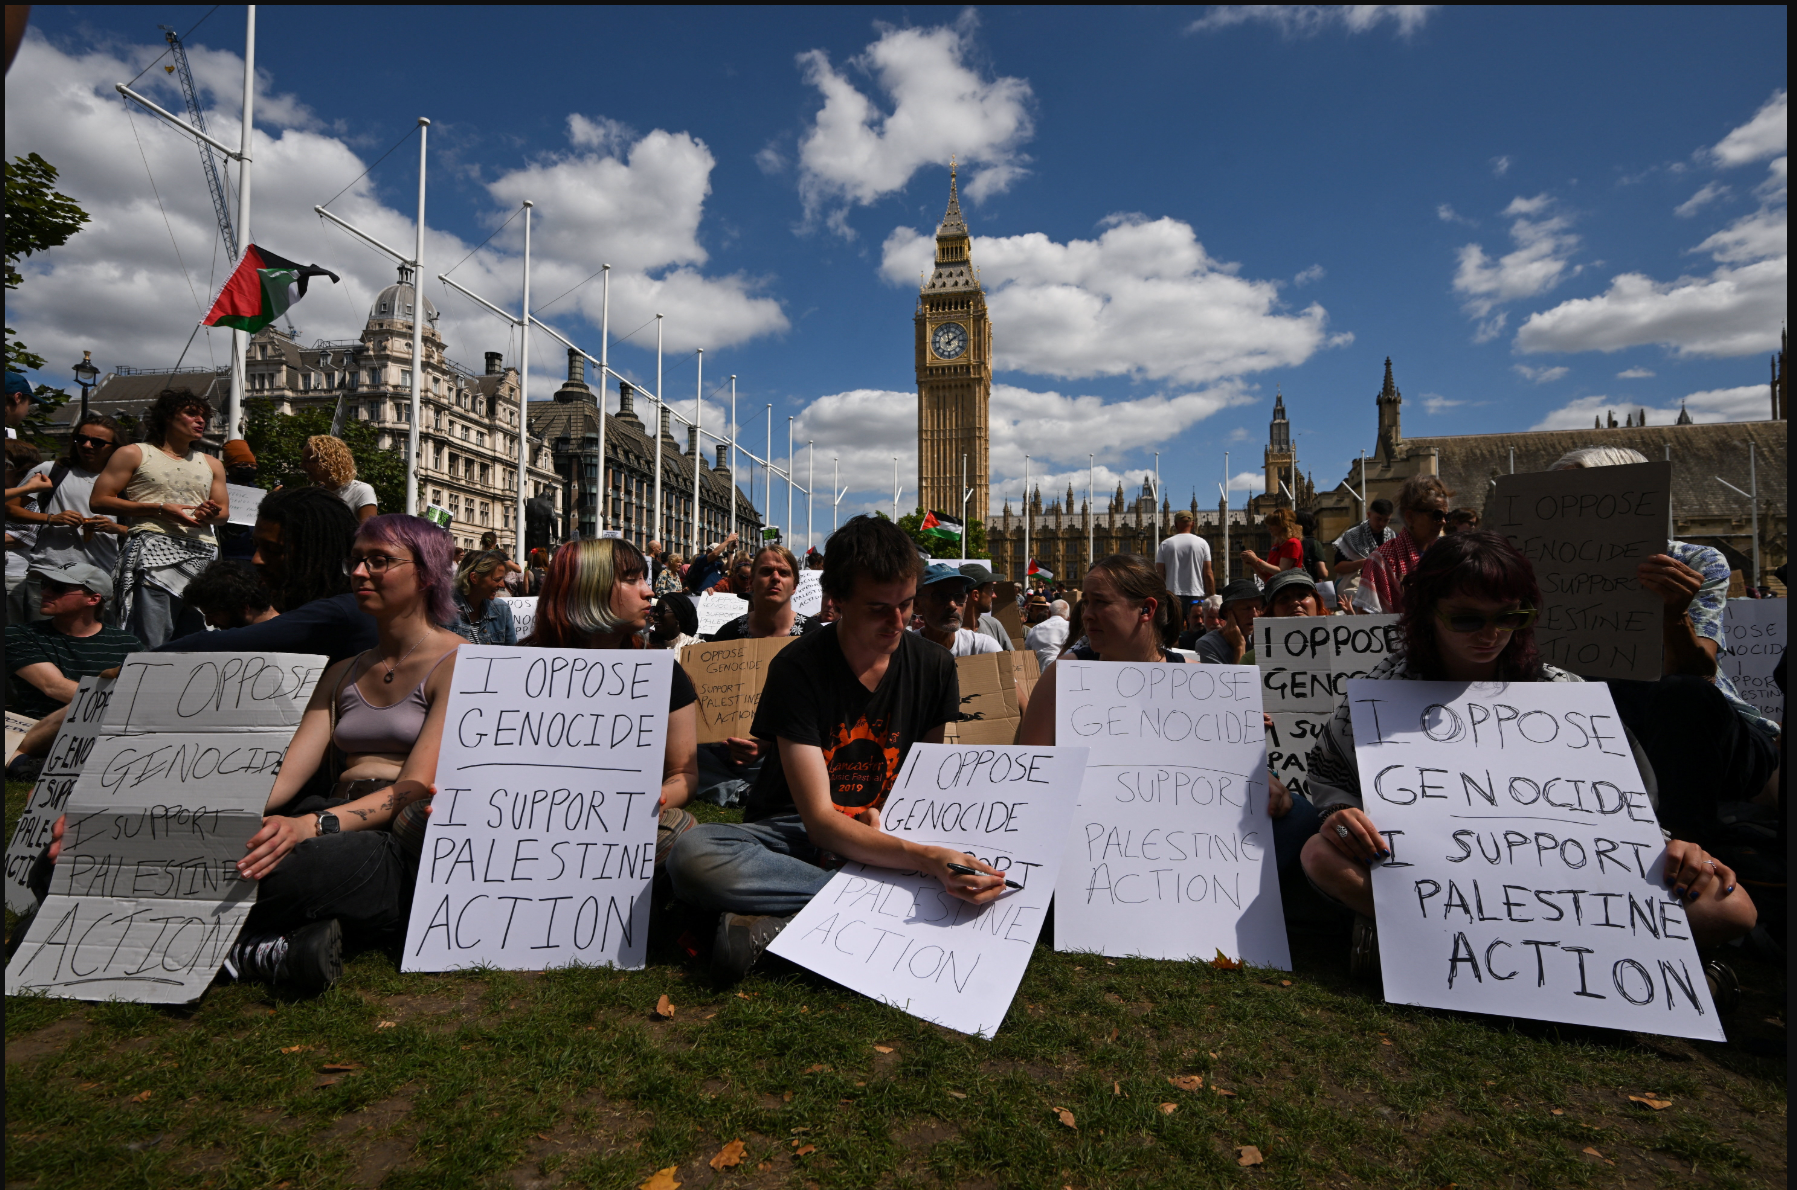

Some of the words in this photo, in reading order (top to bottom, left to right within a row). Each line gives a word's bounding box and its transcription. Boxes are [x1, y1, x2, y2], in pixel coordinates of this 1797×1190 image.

[1501, 495, 1522, 527] I
[1535, 490, 1659, 520] OPPOSE
[1535, 602, 1653, 633] ESTINE
[1727, 606, 1733, 620] I
[687, 650, 691, 663] I
[700, 646, 747, 662] OPPOSE
[1264, 626, 1272, 658] I
[1540, 636, 1637, 671] TION
[460, 656, 521, 694] I
[525, 656, 652, 699] OPPOSE
[706, 659, 762, 674] GENOCIDE
[1069, 665, 1092, 692] I
[1116, 665, 1251, 701] OPPOSE
[1732, 675, 1778, 690] PPOR
[1738, 660, 1742, 676] I
[67, 687, 91, 723] I
[83, 690, 114, 723] OPP
[106, 663, 174, 741] I
[177, 656, 325, 718] OPPOSE
[700, 683, 745, 695] SUPPORT
[458, 707, 655, 749] GENOCIDE
[1070, 703, 1266, 744] GENOCIDE
[1355, 698, 1411, 745] I
[1420, 702, 1626, 757] OPPOSE
[1755, 705, 1784, 715] ION
[47, 733, 96, 772] GENO
[904, 750, 921, 789] I
[936, 750, 1054, 790] OPPOSE
[24, 778, 46, 814] I
[838, 783, 864, 792] 2019
[1115, 769, 1264, 815] SUPPORT
[1374, 764, 1655, 824] GENOCIDE
[63, 808, 110, 852] I
[112, 804, 245, 841] SUPPORT
[433, 788, 472, 826] I
[487, 788, 646, 833] SUPPORT
[884, 798, 1029, 834] GENOCIDE
[431, 837, 654, 884] PALESTINE
[1085, 822, 1260, 862] PALESTINE
[1378, 829, 1414, 868] I
[1445, 829, 1652, 880] SUPPORT
[68, 854, 248, 898] PALESTINE
[1086, 862, 1242, 911] ACTION
[416, 893, 634, 957] ACTION
[1414, 879, 1689, 941] PALESTINE
[18, 902, 242, 981] ACTION
[801, 912, 982, 994] ACTION
[1447, 931, 1705, 1017] ACTION
